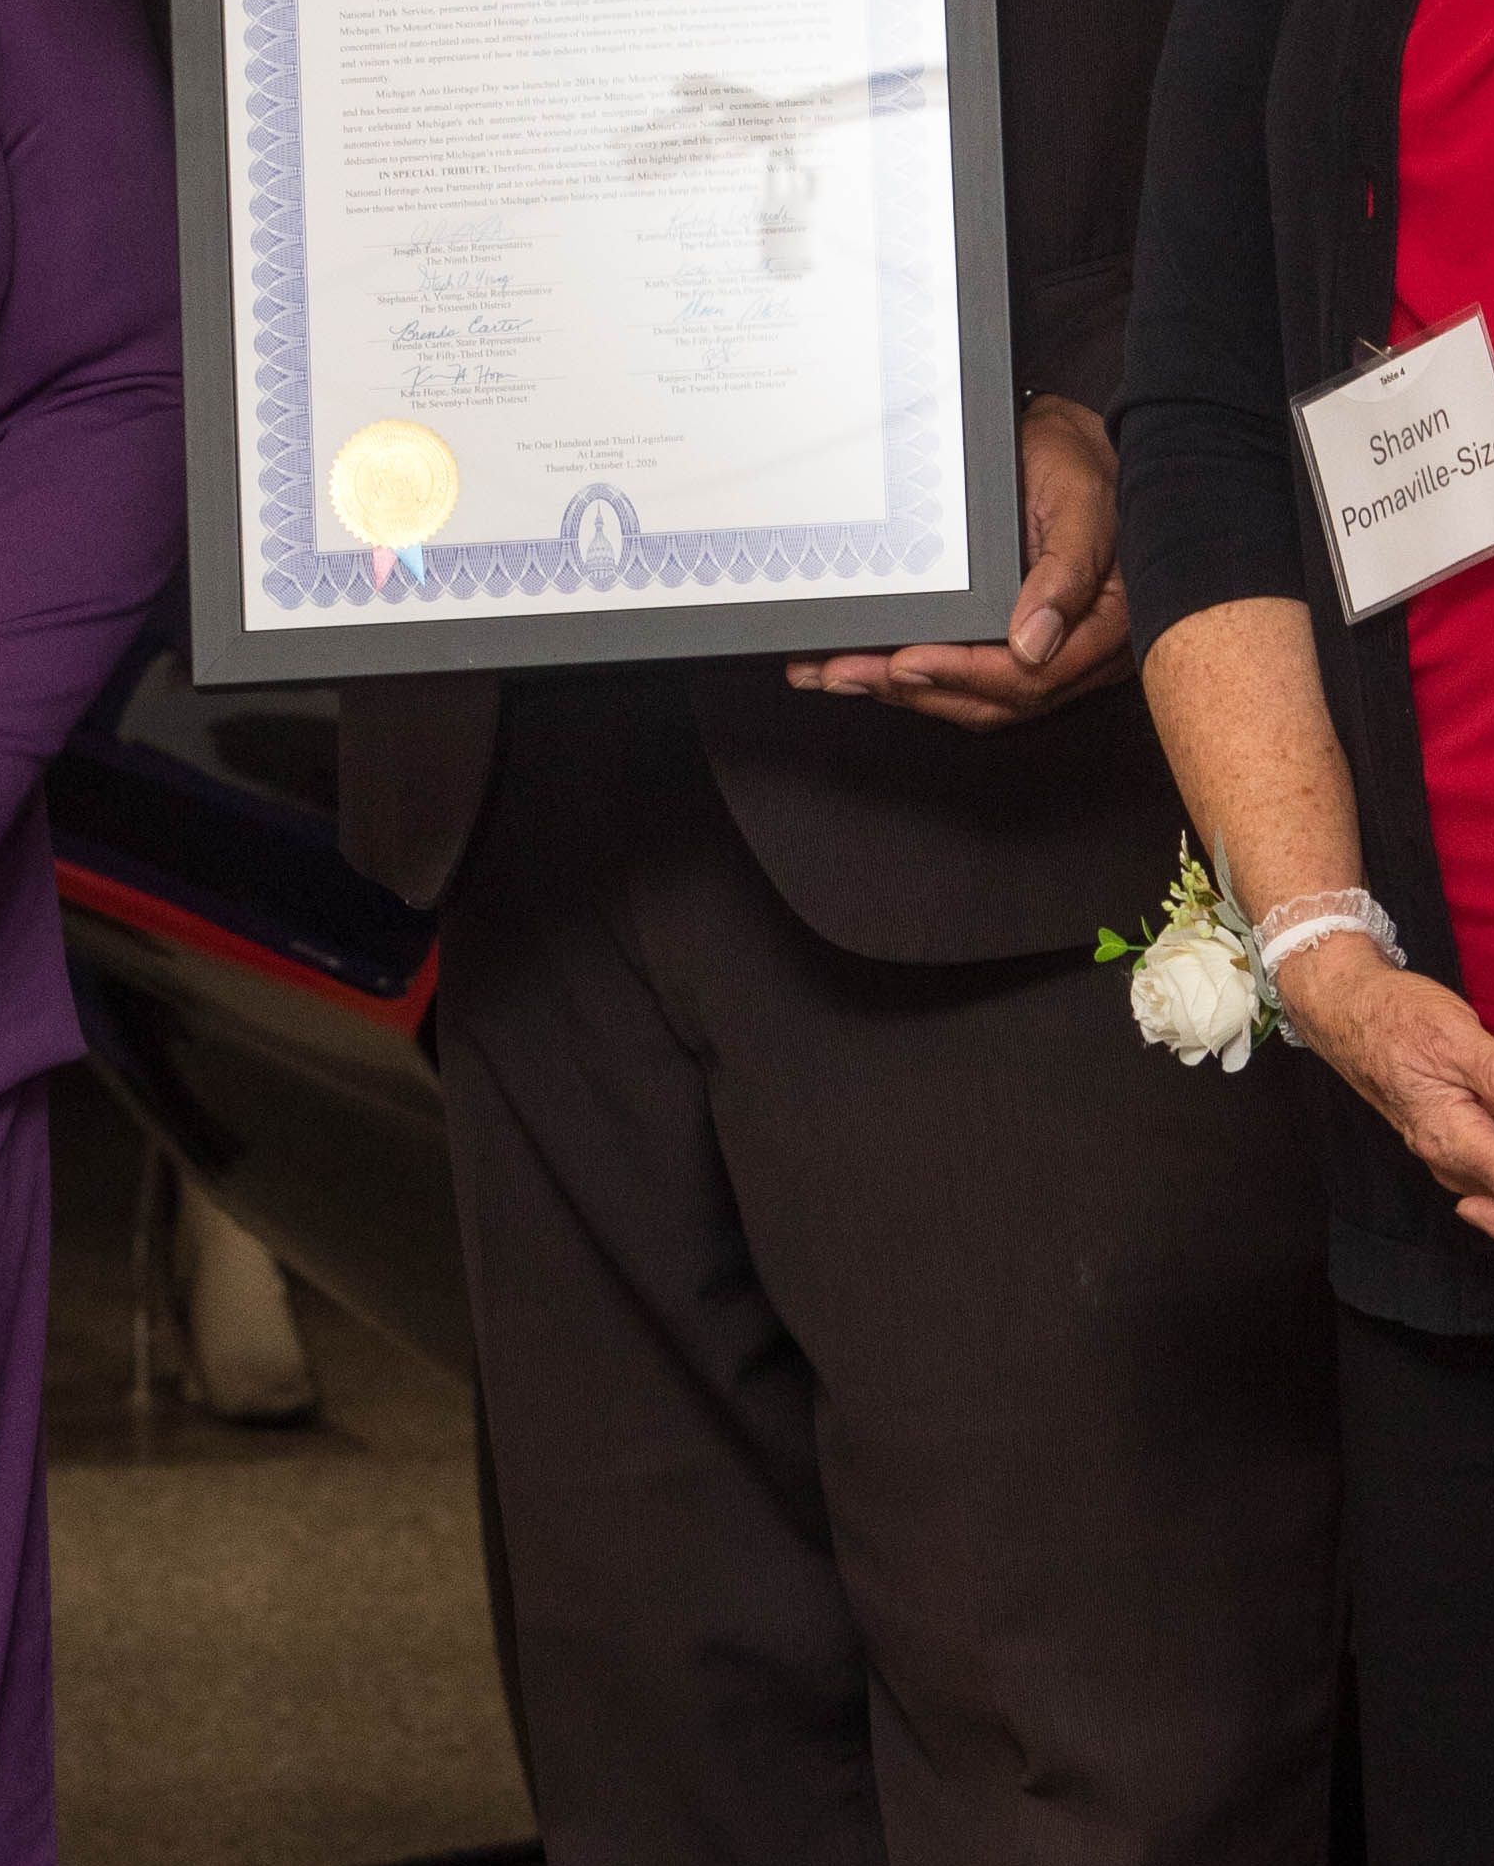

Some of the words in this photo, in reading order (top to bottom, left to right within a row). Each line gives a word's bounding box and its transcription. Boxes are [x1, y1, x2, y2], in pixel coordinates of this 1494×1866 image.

[426, 256, 442, 266] The
[443, 255, 469, 265] Ninth
[469, 253, 502, 264] District
[420, 304, 436, 314] The
[437, 301, 478, 313] Sixteenth
[479, 299, 511, 310] District
[391, 341, 422, 351] Brenda
[424, 339, 453, 349] Carter,
[455, 337, 477, 347] State
[479, 334, 542, 348] Representative
[1379, 370, 1399, 386] Table
[1398, 366, 1406, 379] 4
[516, 441, 533, 451] The
[534, 440, 553, 450] One
[554, 437, 591, 449] Hundred
[593, 436, 610, 446] and
[612, 435, 635, 445] Third
[1369, 407, 1450, 467] Shawn
